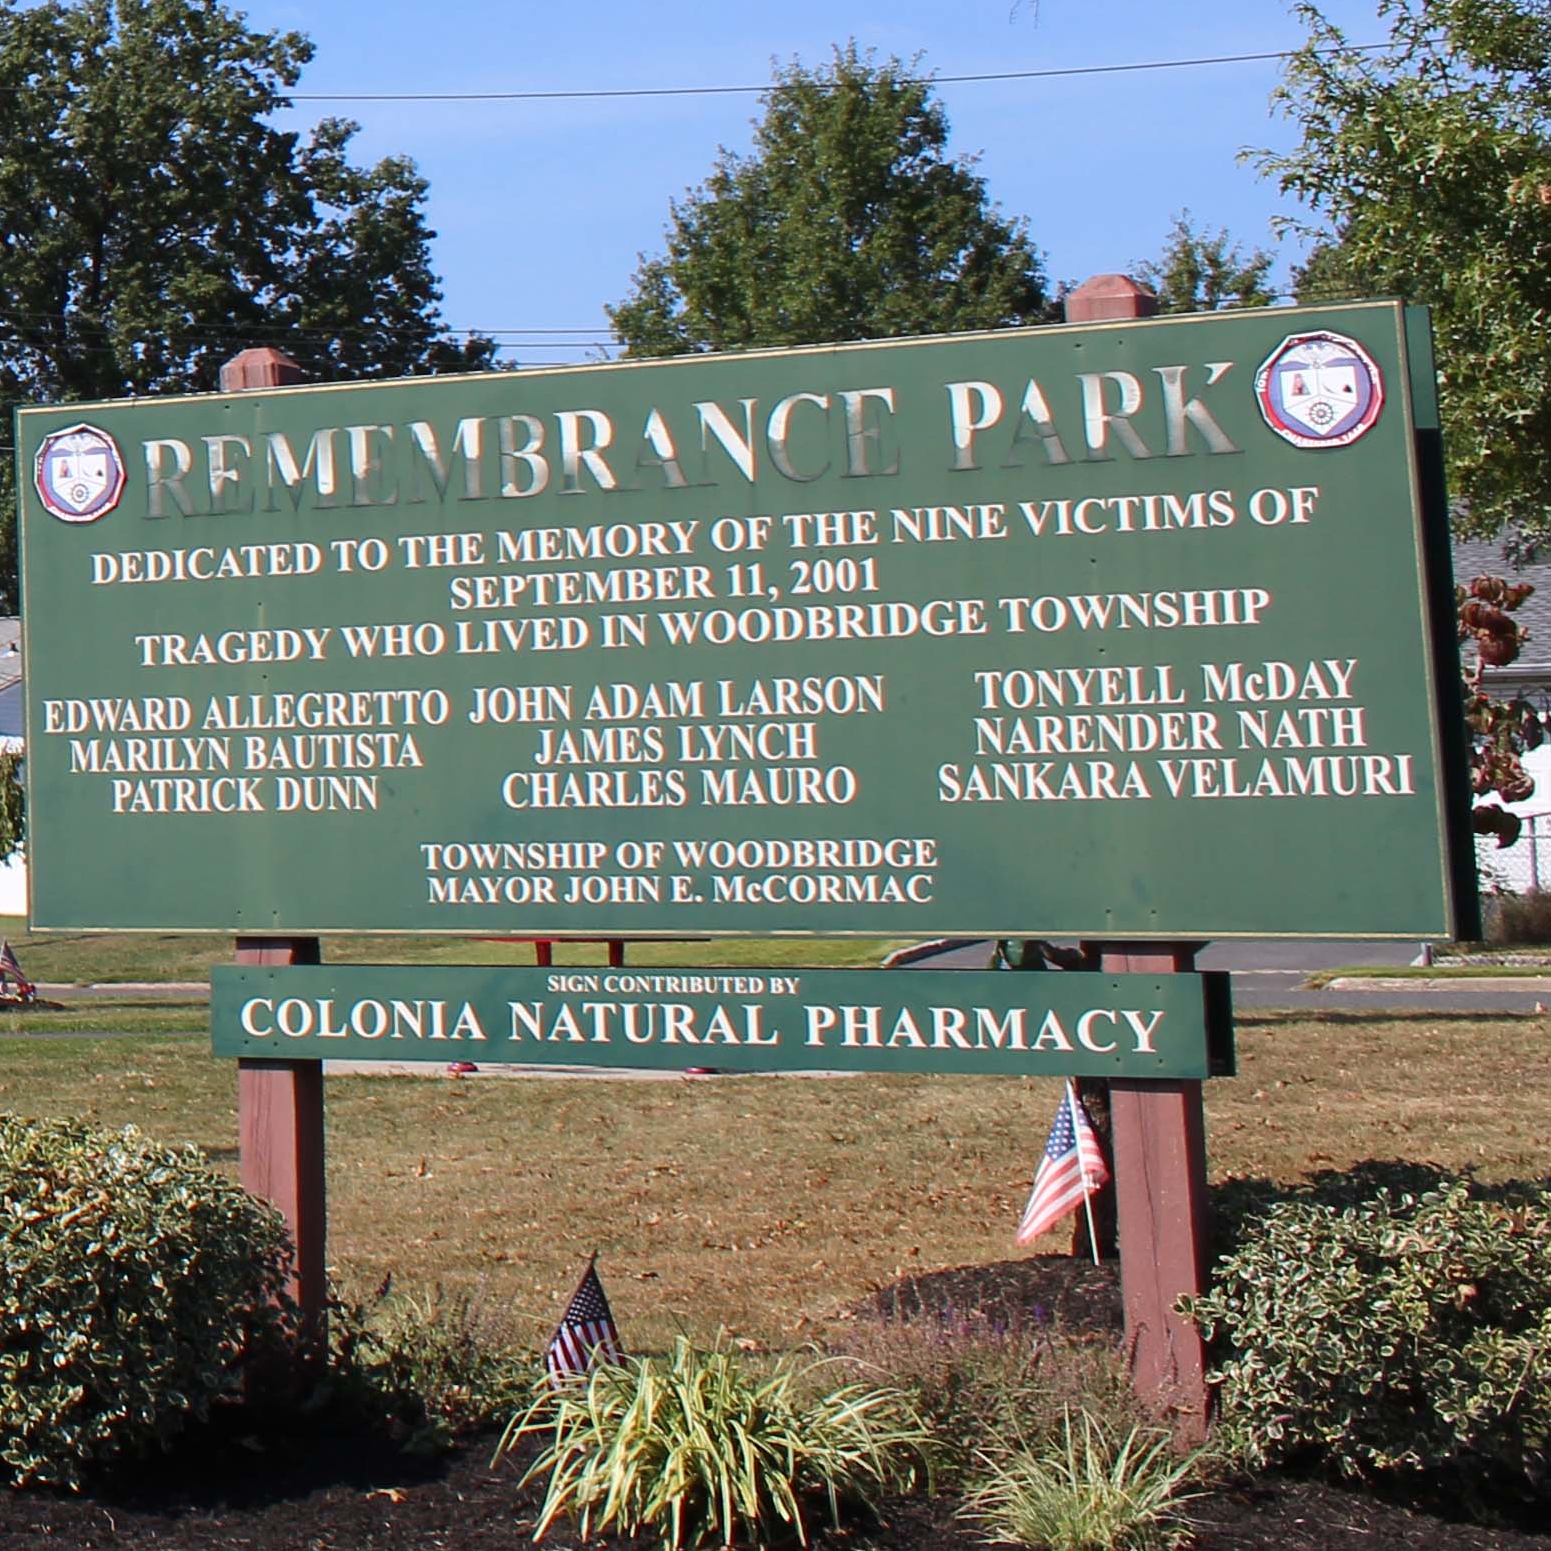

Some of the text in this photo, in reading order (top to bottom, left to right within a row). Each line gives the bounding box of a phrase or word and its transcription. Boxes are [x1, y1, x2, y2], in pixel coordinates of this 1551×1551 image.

[141, 362, 1245, 520] REMEMBRANCE PARK
[90, 485, 1320, 585] DEDICATED TO THE MEMORY OF THE NINE VICTIMS OF
[449, 556, 880, 611] SEPTEMBER 11, 2001
[133, 587, 1271, 667] TRAGEDY WHO LIVED IN WOODBRIDGE TOWNSHIP
[468, 674, 885, 725] JOHN ADAM LARSON
[973, 658, 1359, 710] TONYELL McDAY
[42, 688, 450, 734] EDWARD ALLEGRETTO
[972, 706, 1369, 756] NARENDER NATH
[68, 731, 424, 774] MARILYN BAUTISTA
[534, 721, 819, 766] JAMES LYNCH
[111, 774, 379, 814] PATRICK DUNN
[502, 764, 857, 810] CHARLES MAURO
[938, 753, 1416, 803] SANKARA VELAMURI
[419, 837, 939, 872] TOWNSHIP OF WOODBRIDGE
[427, 873, 934, 905] MAYOR JOHN E. McCORMAC
[546, 974, 801, 996] SIGN CONTRIBUTED BY
[240, 997, 1165, 1054] COLONIA NATURAL PHARMACY
